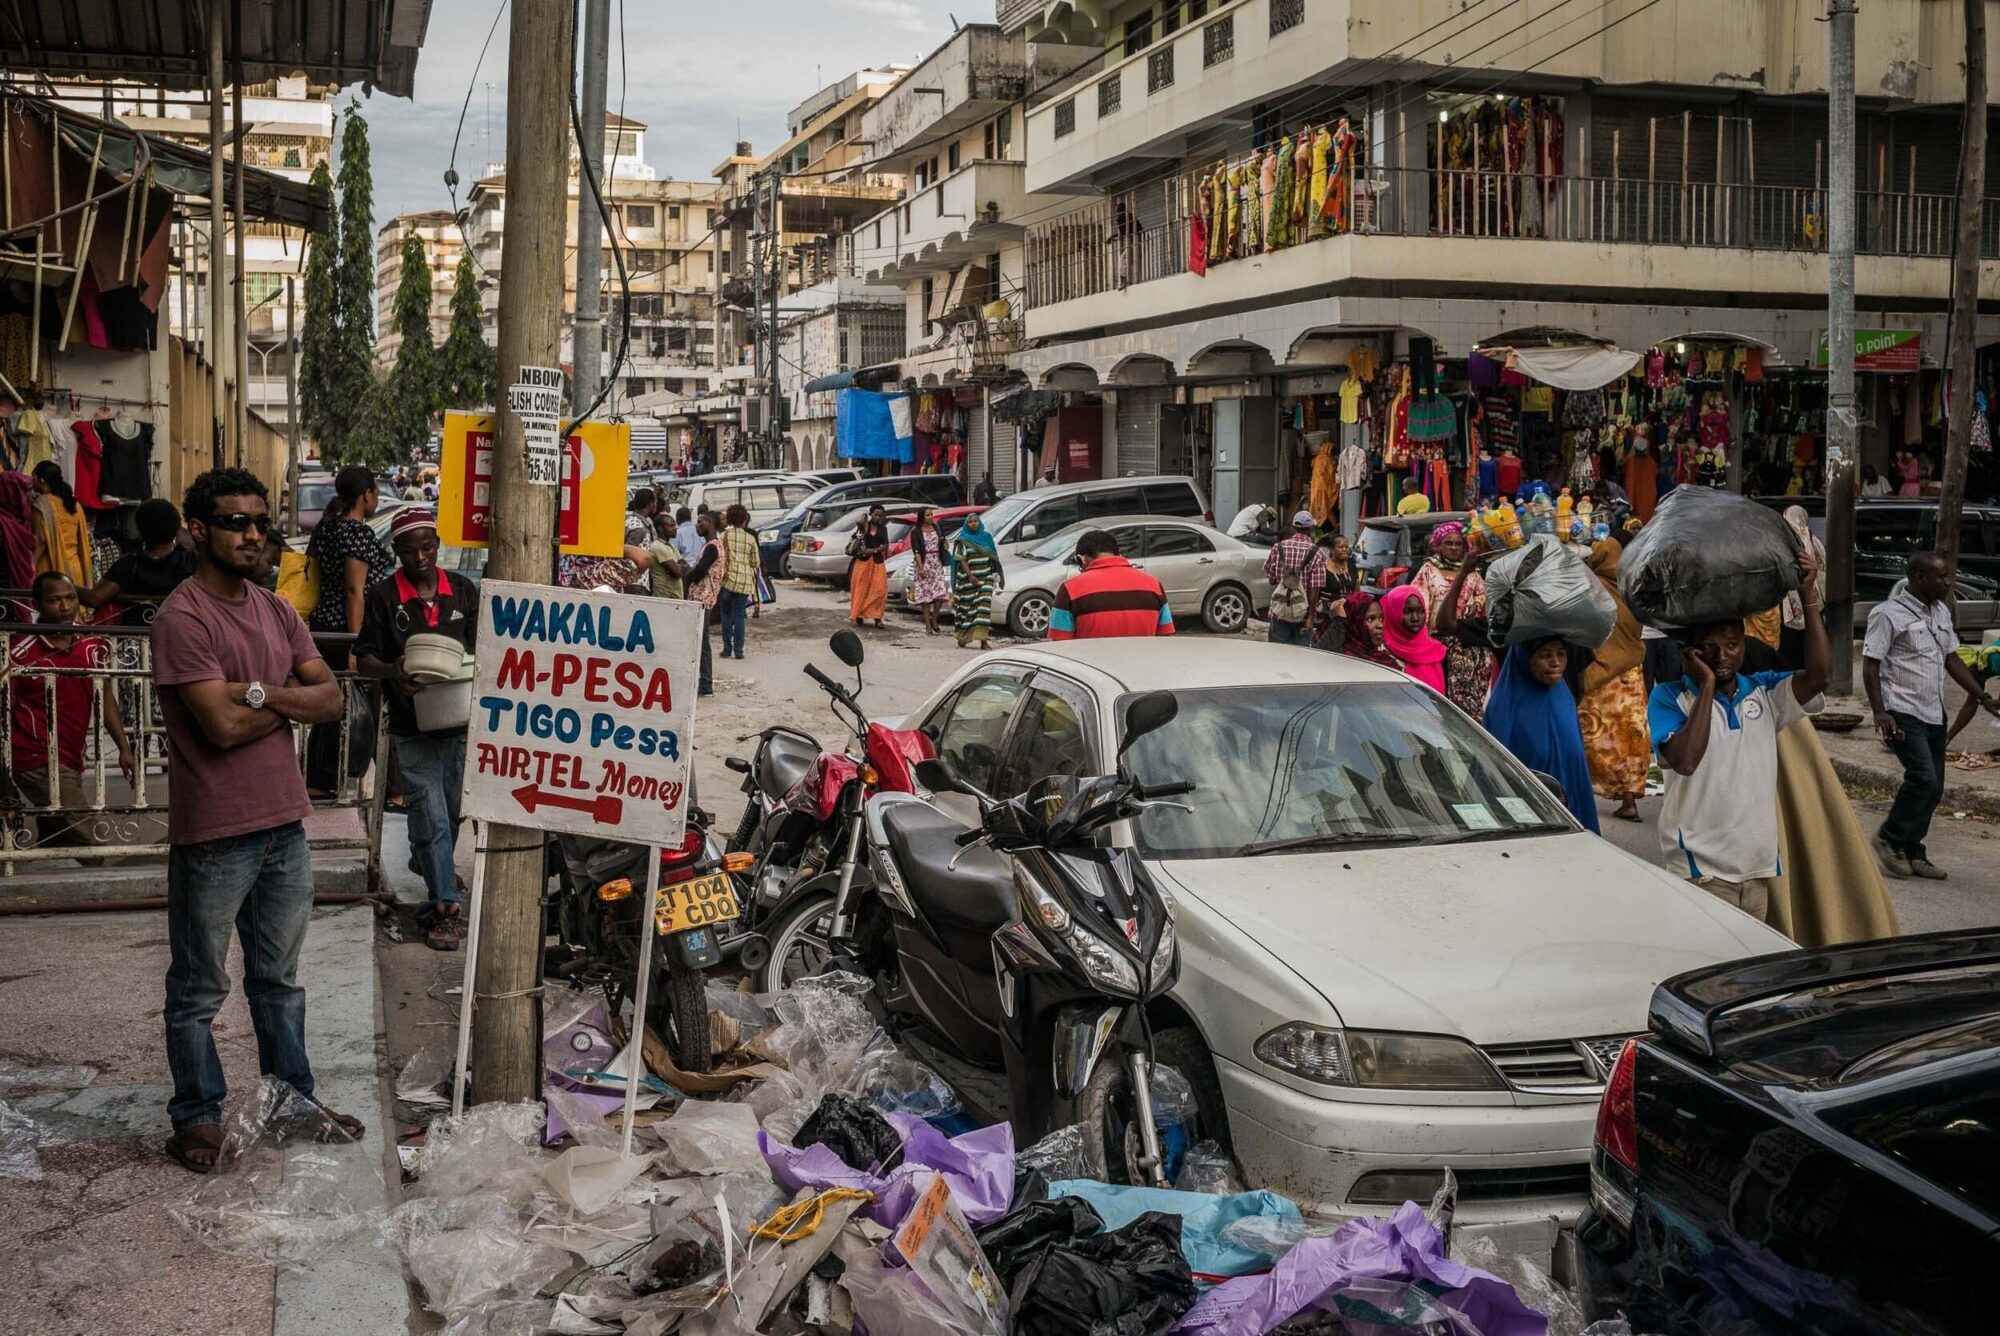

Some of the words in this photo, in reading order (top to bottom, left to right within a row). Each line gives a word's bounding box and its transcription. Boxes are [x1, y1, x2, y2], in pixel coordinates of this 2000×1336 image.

[491, 595, 655, 653] WAKALA
[496, 647, 672, 713] M-PESA
[479, 696, 581, 743] TIGO
[590, 712, 680, 762] Pesa
[476, 743, 591, 790] AIRTEL
[596, 759, 683, 810] Money
